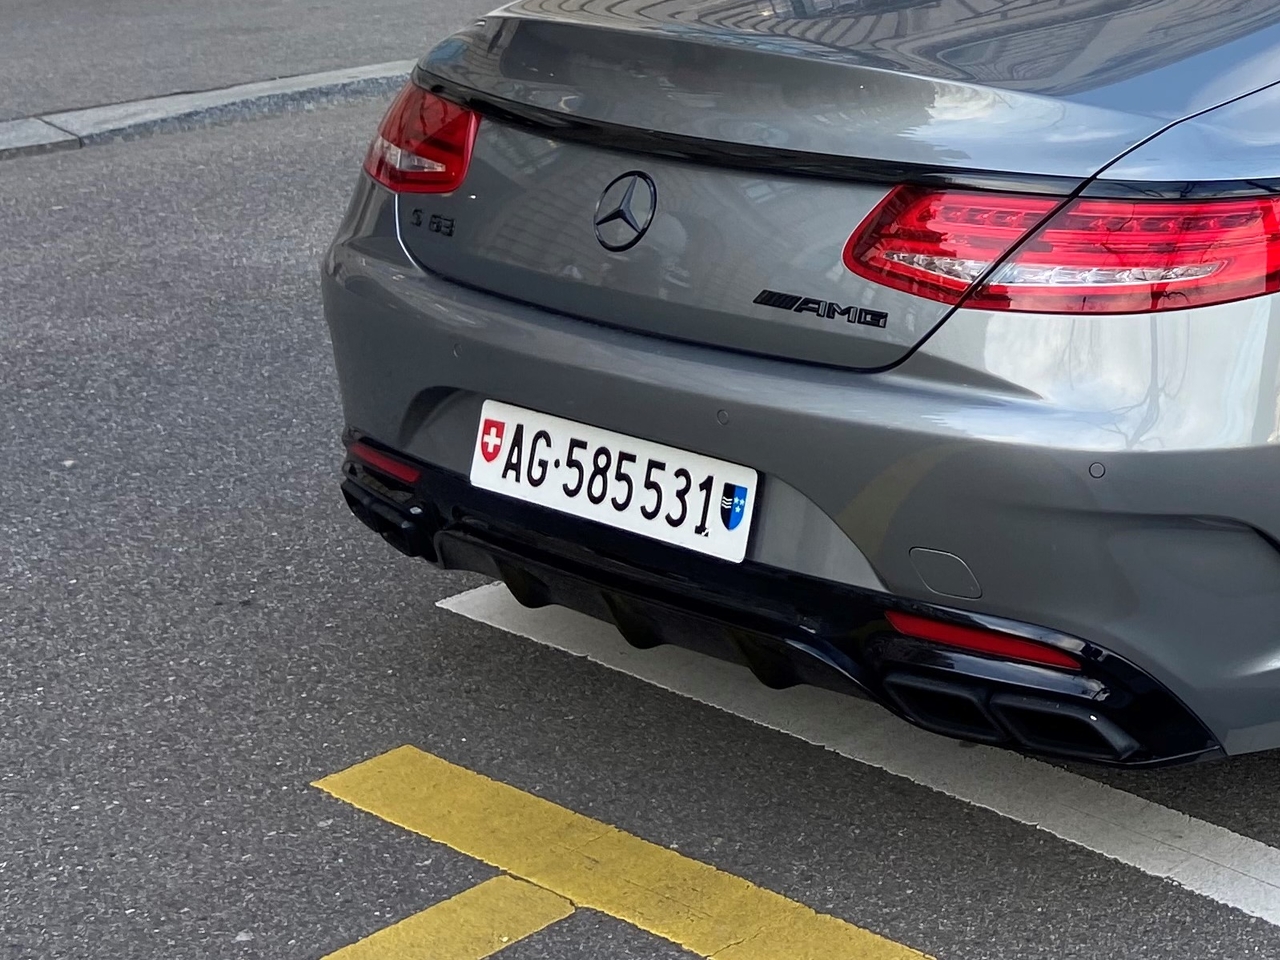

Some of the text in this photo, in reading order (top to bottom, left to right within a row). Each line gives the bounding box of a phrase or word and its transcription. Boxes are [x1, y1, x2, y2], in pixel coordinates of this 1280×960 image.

[410, 208, 455, 237] S 63
[794, 297, 889, 328] AMG
